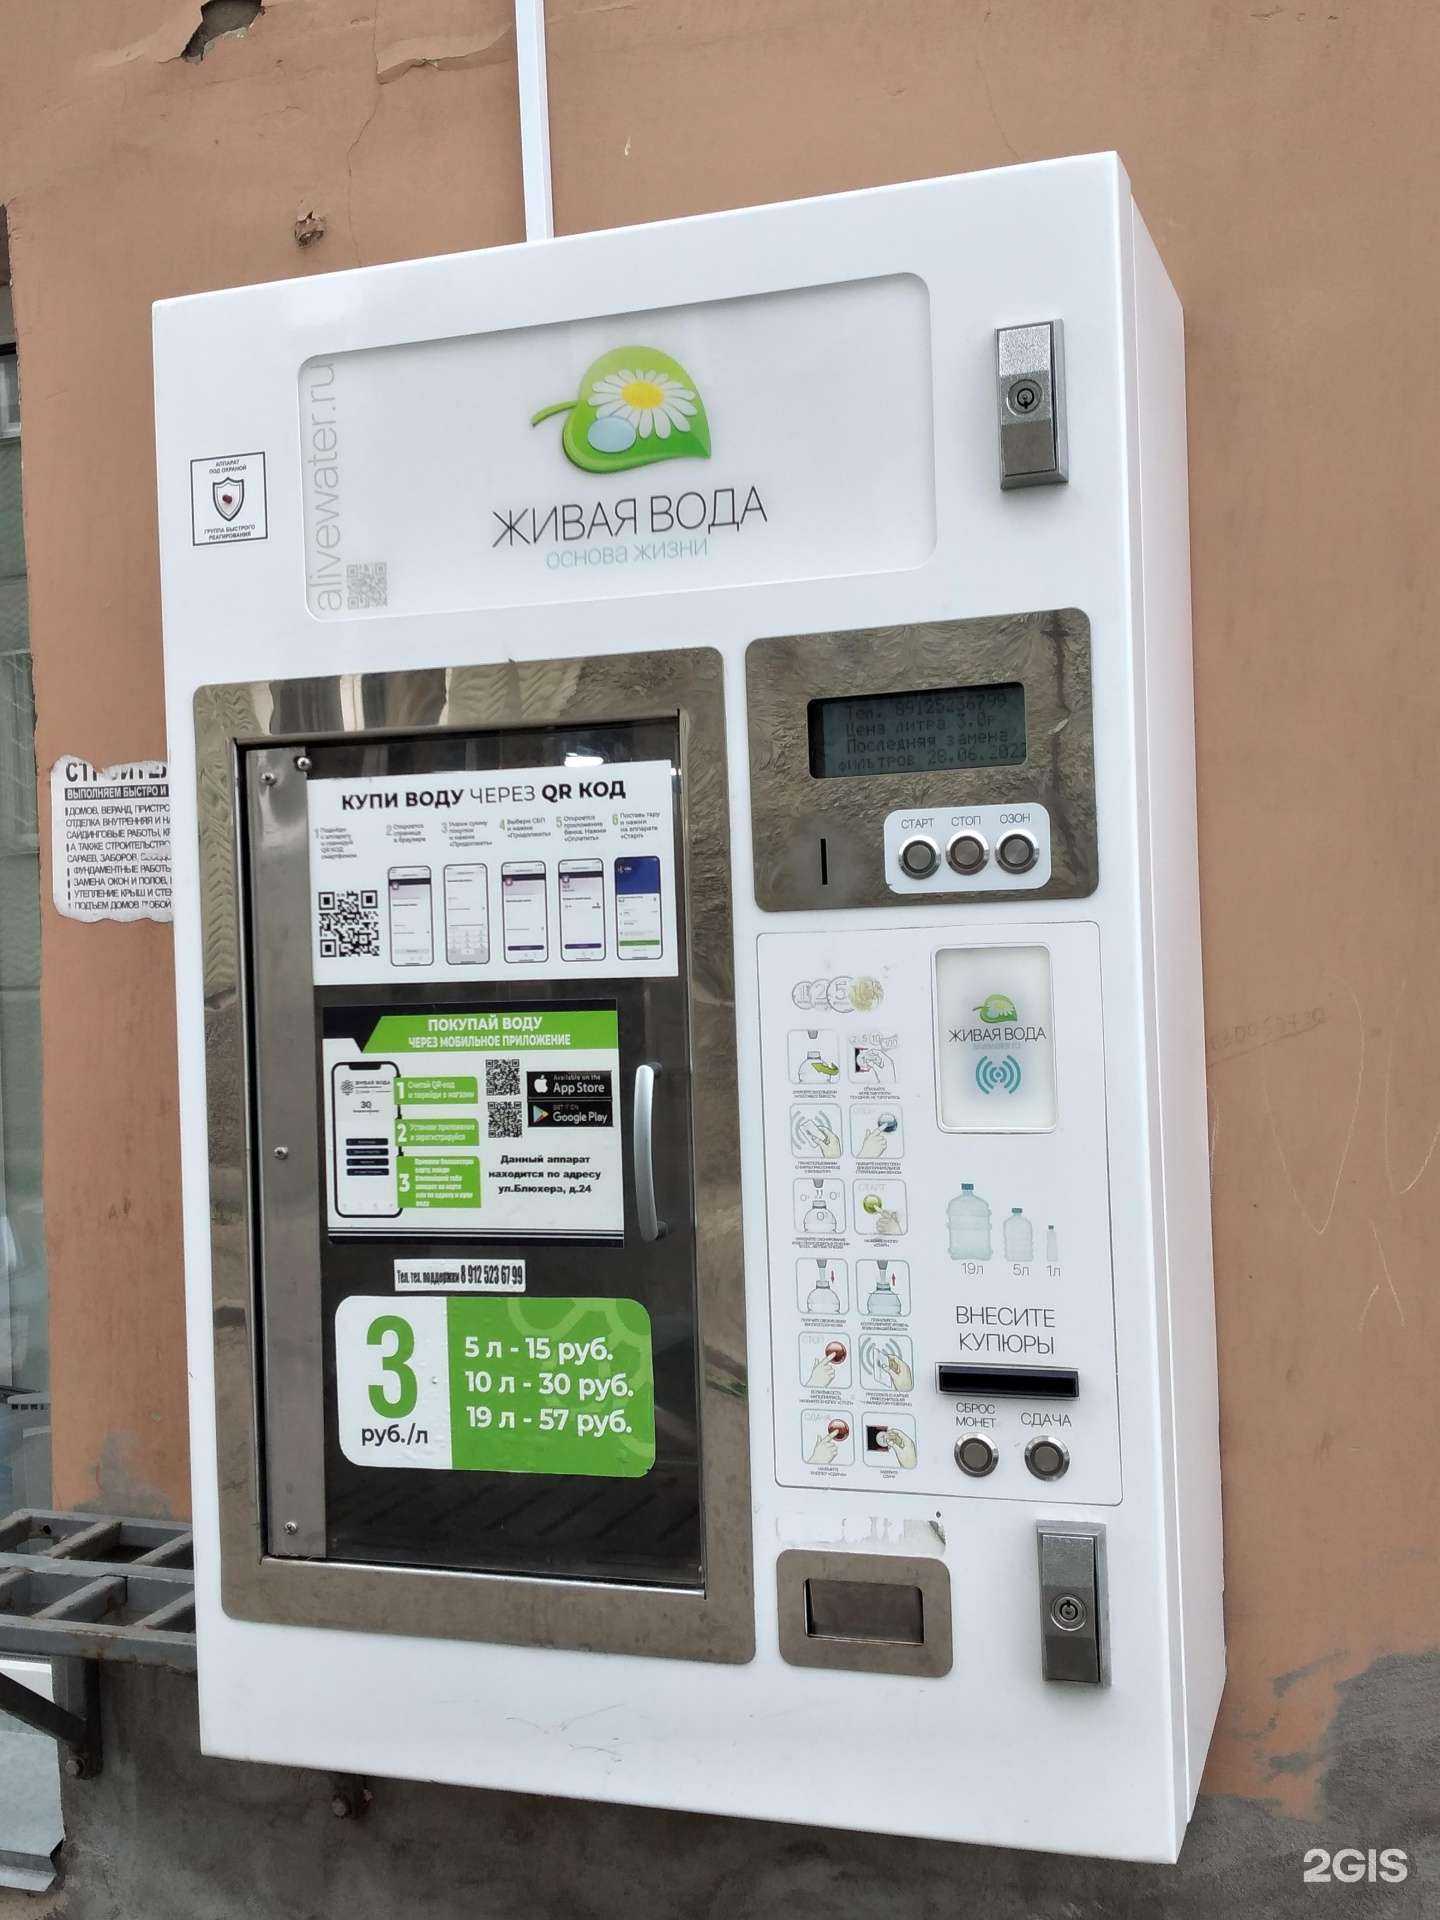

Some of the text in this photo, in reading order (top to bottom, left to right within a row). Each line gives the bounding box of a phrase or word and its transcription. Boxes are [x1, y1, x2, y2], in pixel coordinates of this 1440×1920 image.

[221, 464, 247, 473] ОХРАНОЙ
[308, 363, 342, 612] alivewater.ru
[492, 486, 767, 547] ЖИВАЯ ВОДА
[204, 527, 225, 535] ГРУППА
[546, 538, 708, 569] основа жизни
[896, 719, 947, 733] литра
[847, 735, 936, 754] Последняя
[67, 786, 166, 799] ВЫПОЛНЯЕМ БЫСТРО И
[342, 780, 626, 811] КУПИ ВОДУ ЧЕРЕЗ QR КОД
[66, 817, 160, 828] ОТДЕЛКА ВНУТРЕННЯЯ И
[556, 816, 563, 828] 5
[612, 813, 619, 825] 6
[901, 813, 1030, 829] СТАРТ СТОП ОЗОН
[66, 830, 125, 839] САЙДИНГОВЫЕ
[71, 843, 76, 851] А
[79, 842, 103, 851] ТАКЖЕ
[74, 865, 138, 876] ФУНДАМЕНТНЫЕ
[74, 878, 106, 886] ЗАМЕНА
[108, 877, 129, 886] ОКОН
[131, 877, 137, 885] И
[74, 889, 153, 898] УТЕПЛЕНИЕ КРЫШ И
[428, 1014, 543, 1032] ПОКУПАЙ ВОДУ
[408, 1034, 571, 1048] ЧЕРЕЗ МОБИЛЬНОЕ ПРИЛОЖЕНИЕ
[949, 1027, 1047, 1042] ЖИВАЯ ВОДА
[397, 1082, 405, 1099] 1
[553, 1081, 605, 1095] App Store
[552, 1111, 607, 1123] Google Play
[397, 1124, 407, 1142] 2
[501, 1155, 589, 1165] Данный аппарат
[399, 1173, 410, 1192] 3
[489, 1171, 543, 1179] находится
[563, 1171, 600, 1180] адресу
[569, 1185, 592, 1194] д.24
[423, 1272, 459, 1285] поддержки
[461, 1265, 465, 1283] 8
[468, 1265, 482, 1283] 912
[484, 1265, 499, 1284] 523
[501, 1265, 510, 1284] 67
[512, 1265, 523, 1284] 99
[961, 1262, 1061, 1276] 19л 5л 1л
[956, 1306, 1055, 1328] ВНЕСИТЕ
[464, 1337, 479, 1358] 5
[487, 1342, 502, 1358] л
[525, 1337, 551, 1359] 15
[558, 1336, 613, 1365] руб.
[959, 1332, 1054, 1355] КУПЮРЫ
[366, 1314, 418, 1419] 3
[465, 1371, 492, 1393] 10
[499, 1377, 515, 1393] л
[538, 1373, 571, 1395] 30
[579, 1373, 634, 1401] руб.
[956, 1402, 996, 1414] СБРОС
[466, 1406, 492, 1428] 19
[499, 1412, 515, 1429] л
[539, 1408, 568, 1430] 57
[577, 1409, 632, 1437] руб.
[956, 1416, 997, 1428] МОНЕТ
[1020, 1412, 1072, 1428] СДАЧА
[361, 1422, 428, 1447] руб./л
